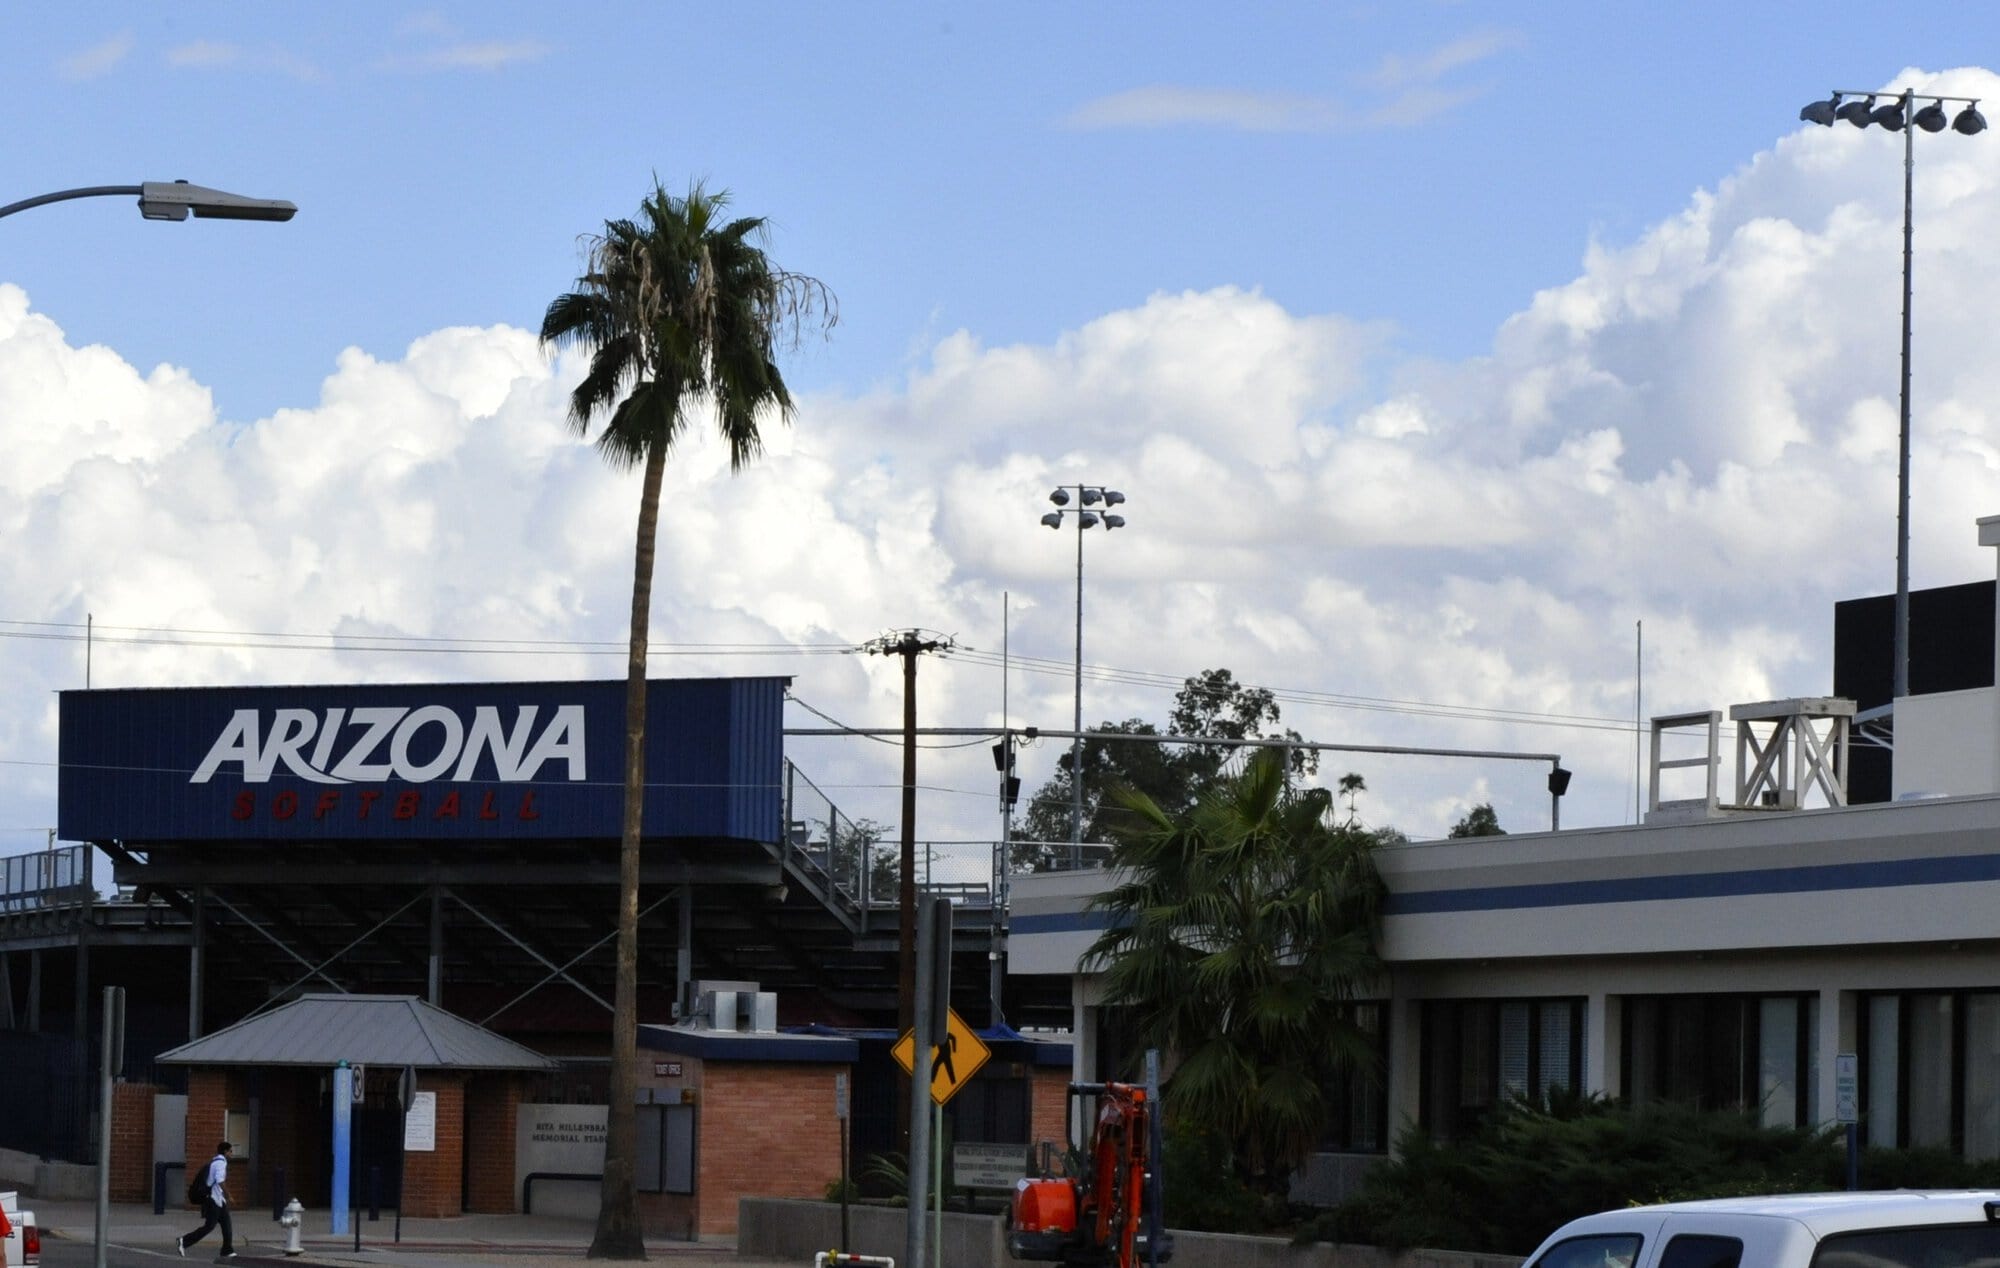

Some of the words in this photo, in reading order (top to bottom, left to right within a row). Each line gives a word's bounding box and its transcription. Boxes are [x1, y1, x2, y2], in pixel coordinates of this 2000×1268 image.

[188, 704, 587, 785] ARIZONA
[230, 790, 541, 821] SOFTBALL
[558, 1123, 607, 1132] HILLENBRA
[532, 1134, 580, 1143] MEMORIAL
